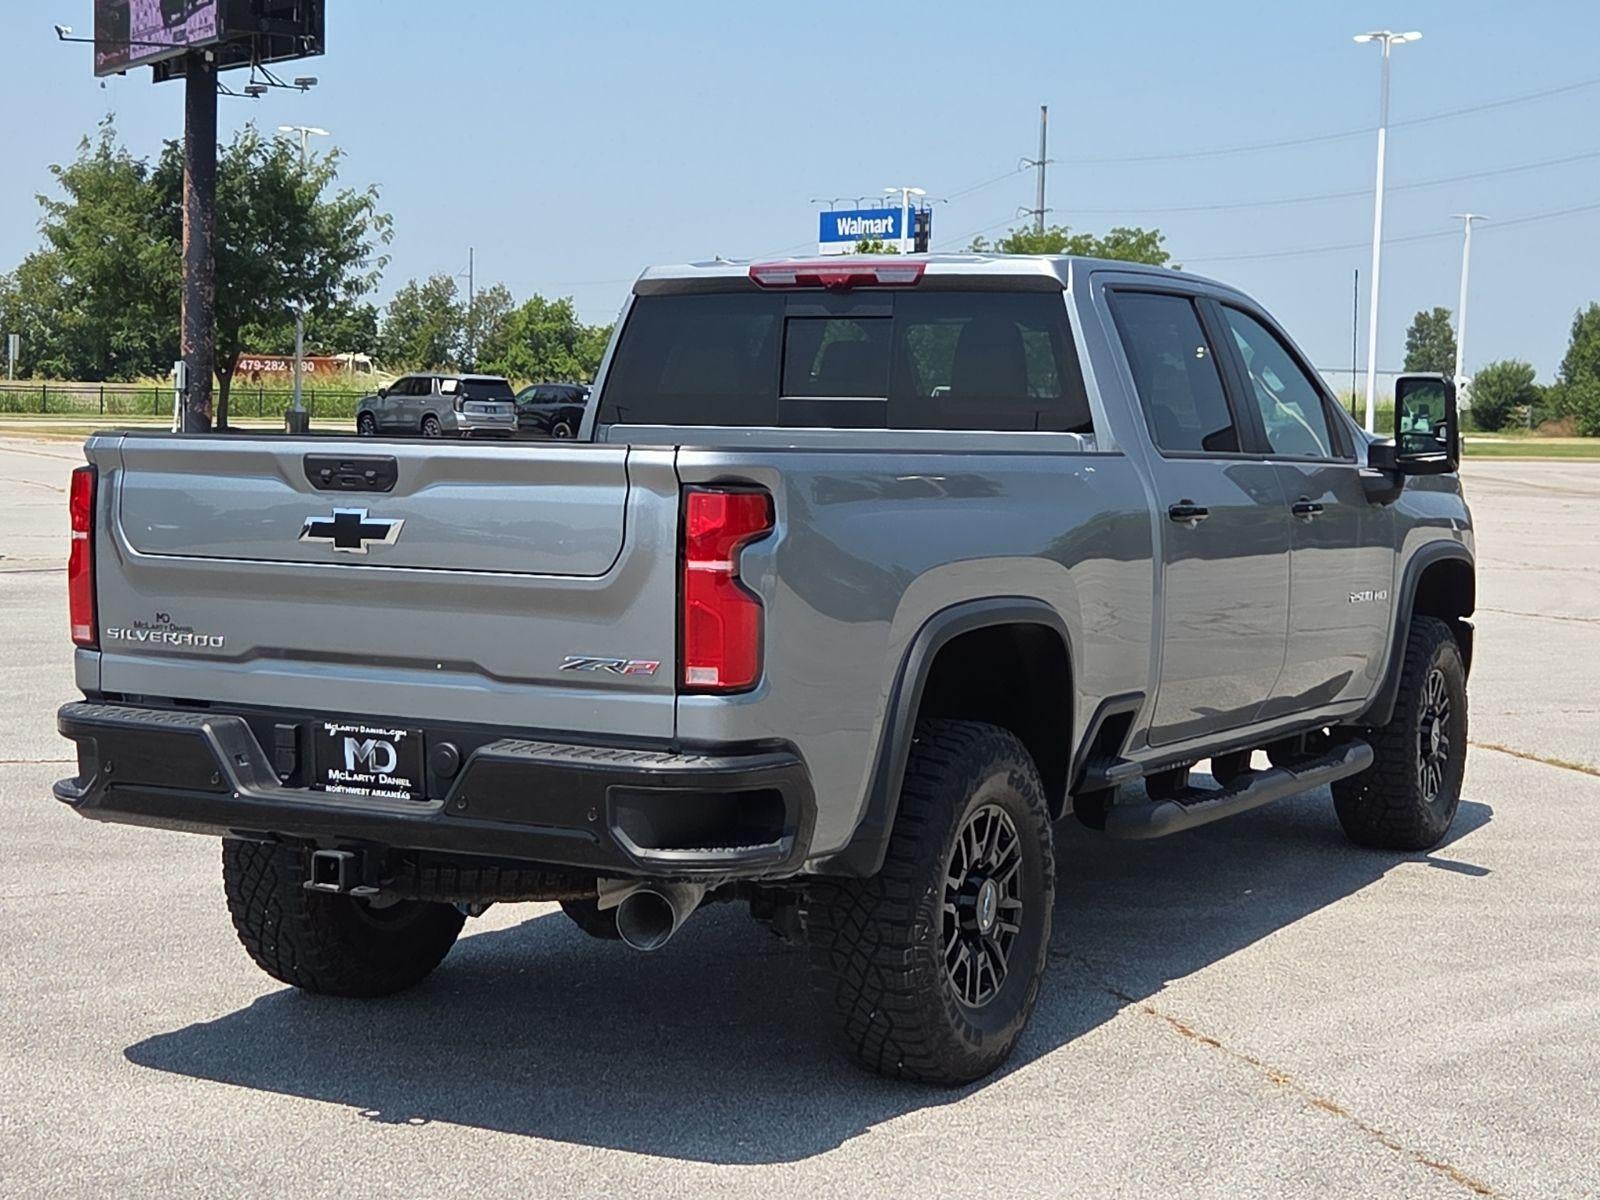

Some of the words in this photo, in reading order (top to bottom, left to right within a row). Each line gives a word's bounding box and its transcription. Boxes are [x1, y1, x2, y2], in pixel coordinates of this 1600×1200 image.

[837, 215, 894, 236] Walmart
[106, 627, 225, 648] SILVERADO
[558, 655, 661, 675] ZR2
[344, 736, 397, 773] MD
[325, 784, 371, 796] NORTHWEST
[371, 788, 411, 800] ARKANSAS
